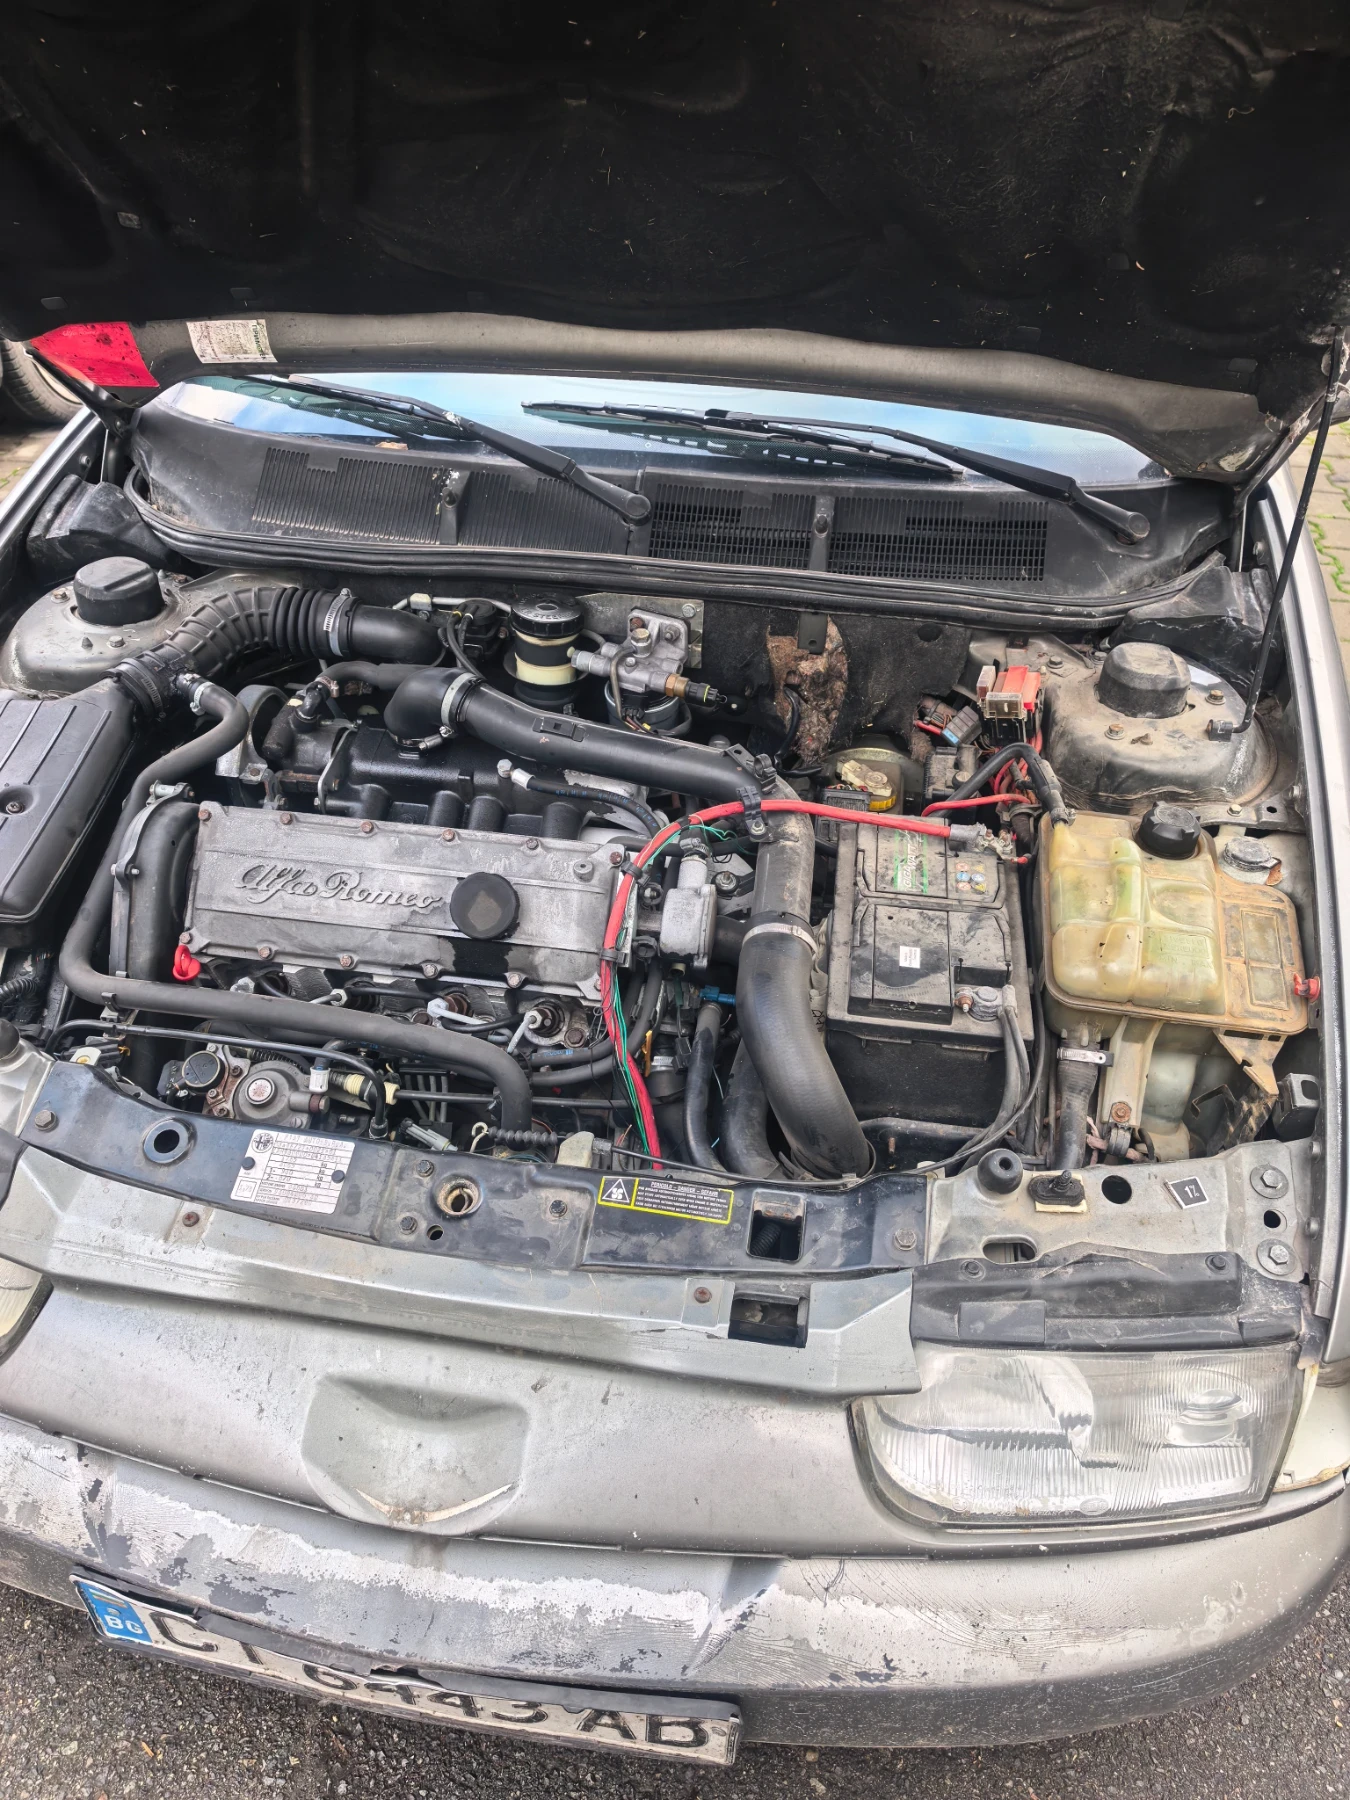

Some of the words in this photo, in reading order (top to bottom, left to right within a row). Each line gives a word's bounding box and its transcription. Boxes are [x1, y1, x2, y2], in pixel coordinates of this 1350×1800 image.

[234, 863, 318, 904] Alfa
[320, 871, 443, 909] Romeo
[1184, 1184, 1200, 1198] 1%
[104, 1614, 144, 1635] BG
